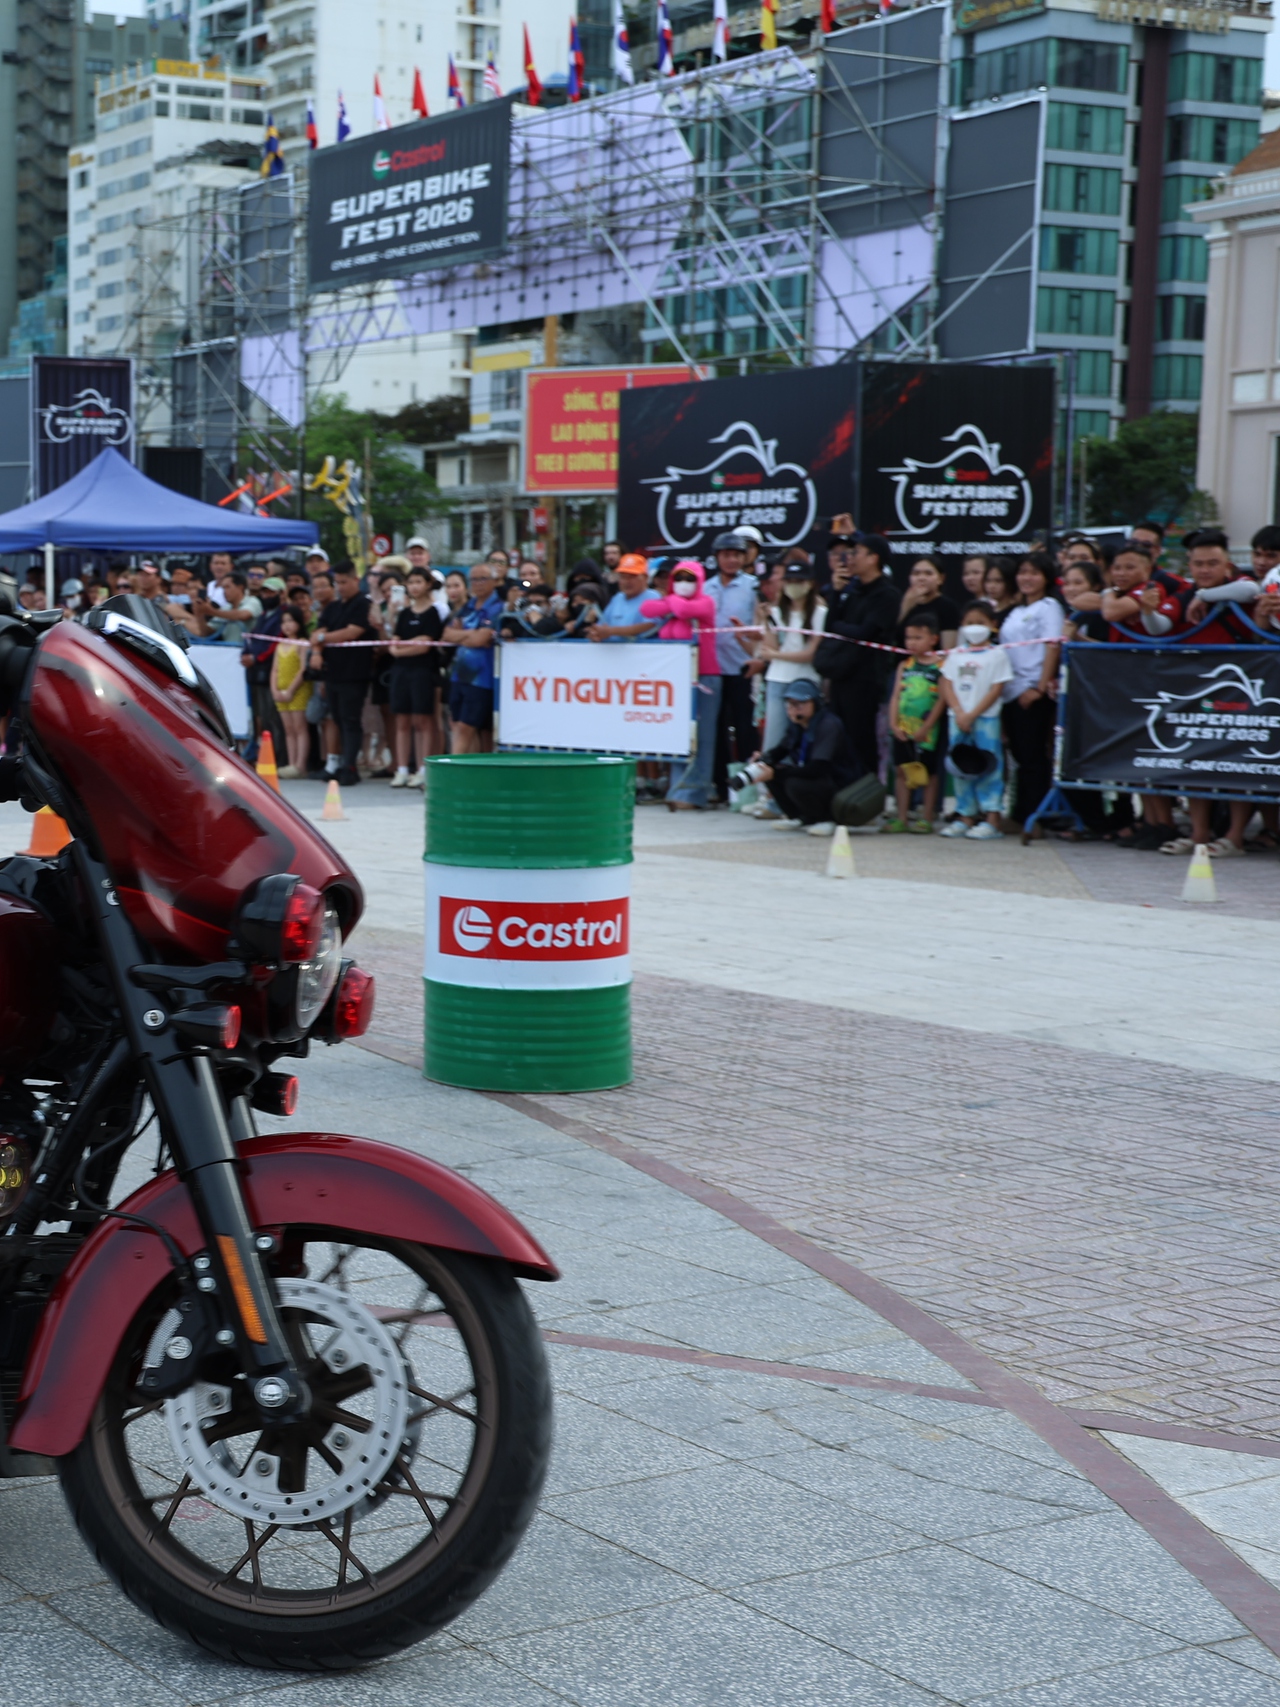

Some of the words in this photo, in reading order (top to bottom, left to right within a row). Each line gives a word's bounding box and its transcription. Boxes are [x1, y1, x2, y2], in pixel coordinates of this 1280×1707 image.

[391, 139, 446, 171] Castrol
[327, 163, 491, 224] SUPERBIKE
[339, 212, 412, 250] FEST
[412, 197, 474, 233] 2026
[331, 258, 353, 271] ONE
[353, 251, 379, 266] RIDE
[384, 245, 408, 260] ONE
[408, 231, 481, 255] CONNECTION
[675, 487, 800, 510] SUPERBIKE
[912, 484, 1019, 500] SUPERBIKE
[684, 510, 740, 528] FEST
[740, 507, 787, 526] 2026
[920, 501, 970, 517] FEST
[970, 501, 1009, 517] 2026
[888, 541, 907, 554] NE
[623, 710, 673, 723] GROUP
[1165, 712, 1280, 728] SUPERBIKE
[1175, 726, 1226, 740] FEST
[1226, 728, 1270, 742] 2026
[1132, 756, 1156, 768] ONE
[1190, 759, 1216, 771] ONE
[498, 913, 622, 948] Castrol
